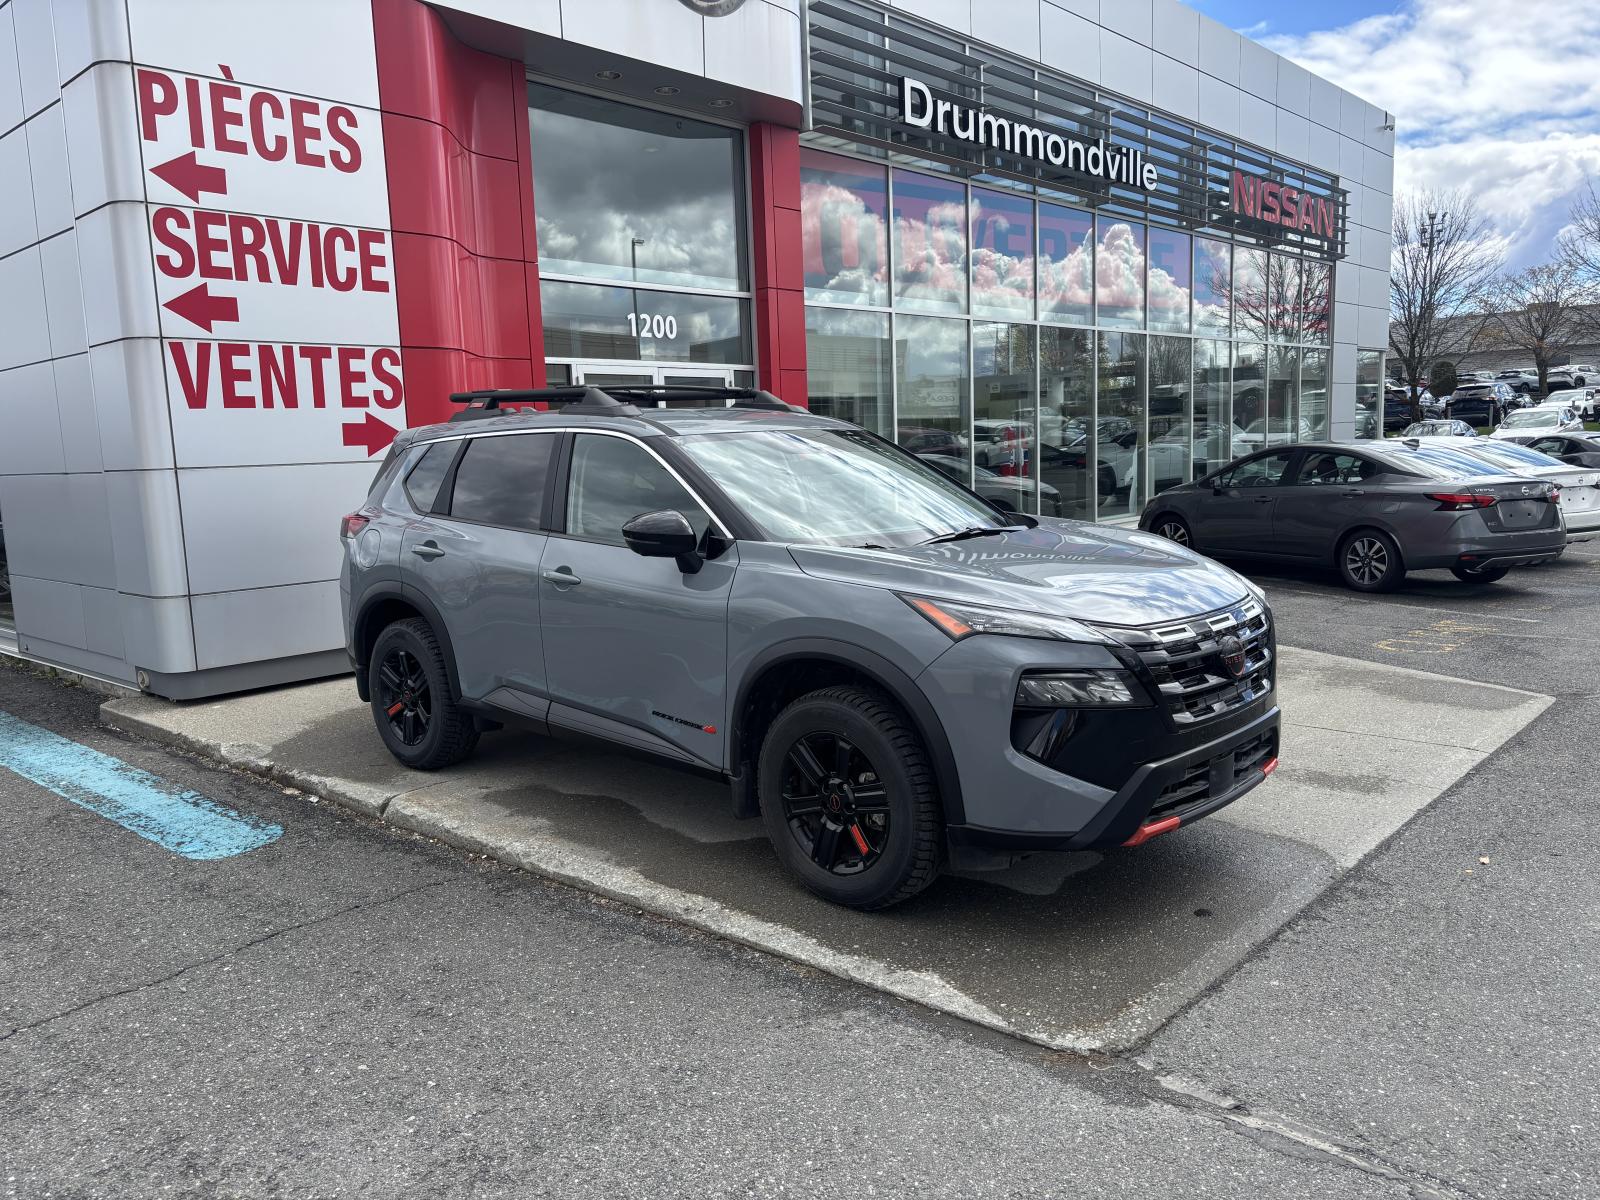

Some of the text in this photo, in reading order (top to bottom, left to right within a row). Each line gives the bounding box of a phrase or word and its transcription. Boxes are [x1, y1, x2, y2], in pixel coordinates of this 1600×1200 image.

[136, 63, 363, 174] PIÈCES
[902, 75, 1159, 192] Drummondville
[1233, 169, 1335, 239] NISSAN
[151, 206, 391, 293] SERVICE
[626, 312, 678, 340] 1200
[168, 341, 404, 410] VENTES
